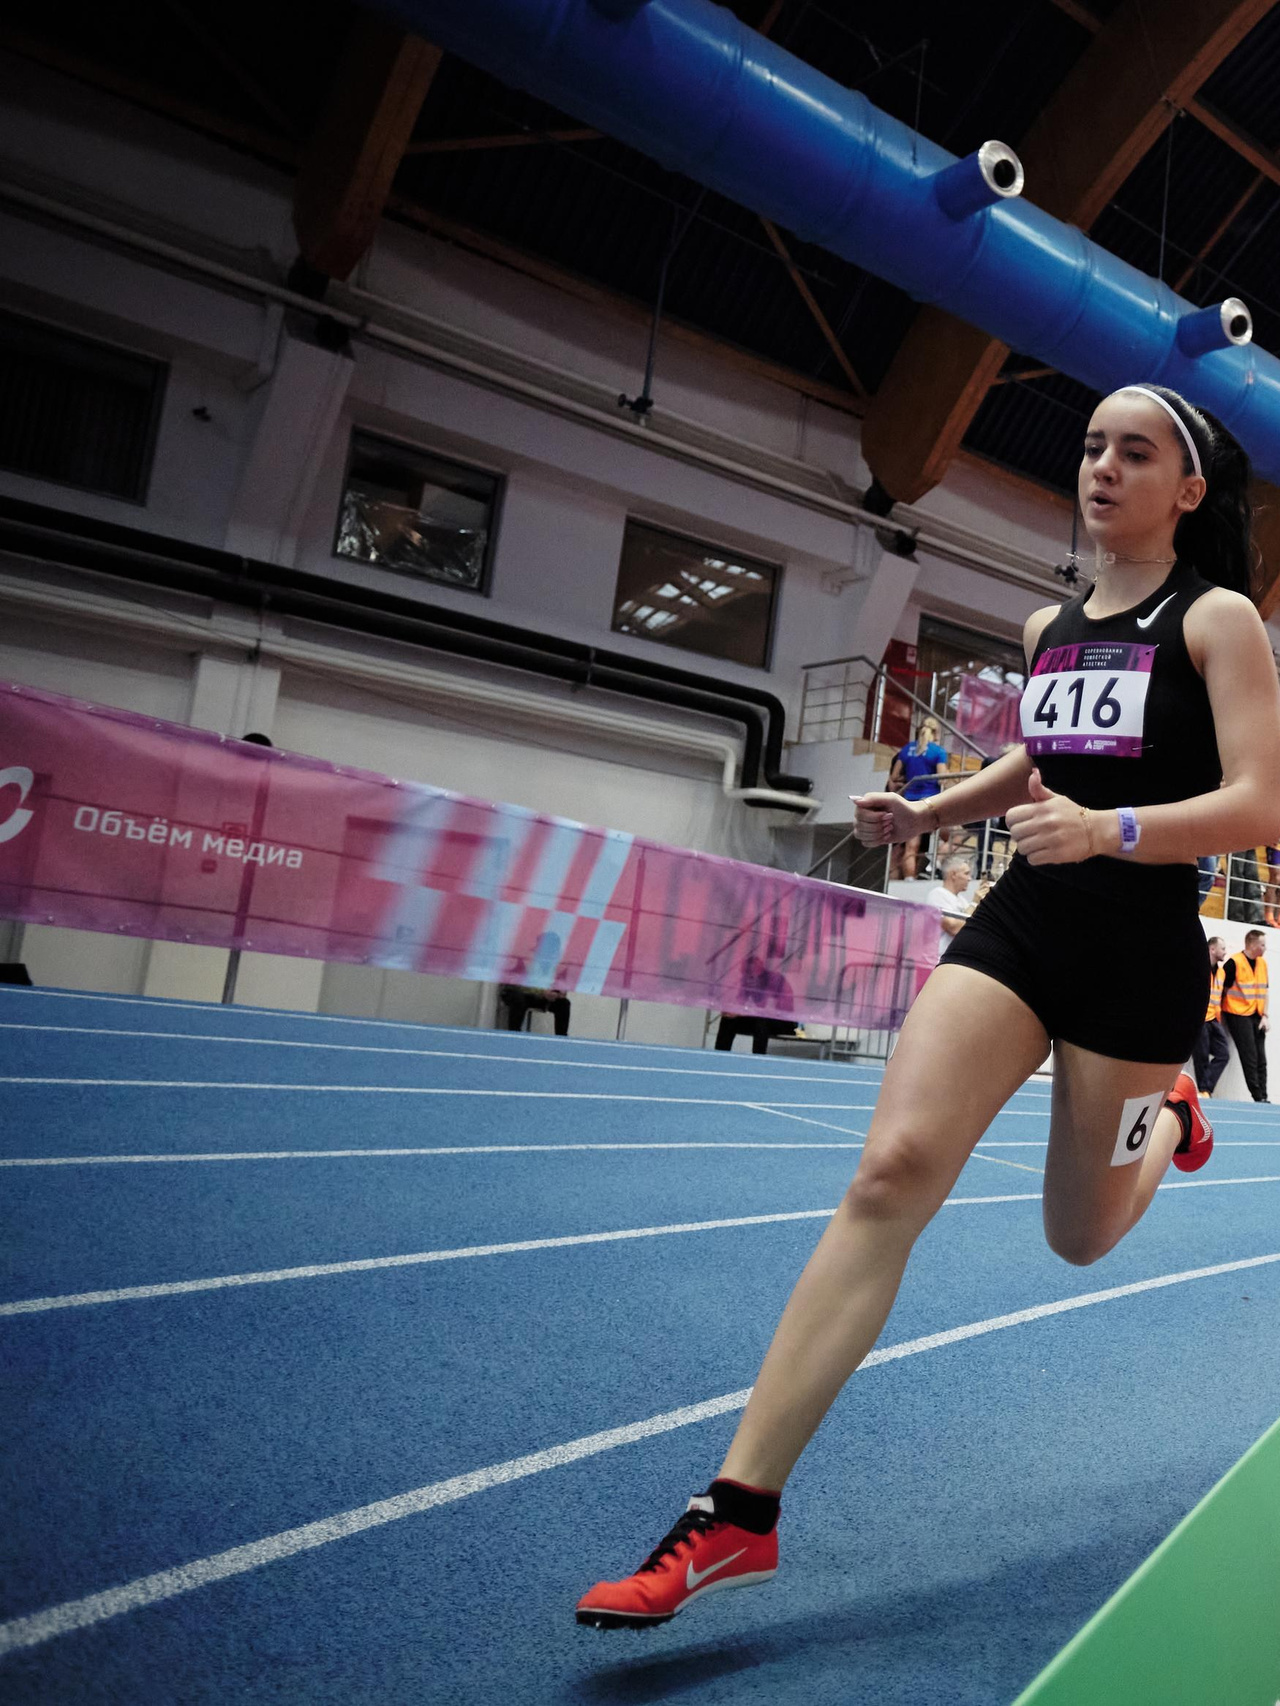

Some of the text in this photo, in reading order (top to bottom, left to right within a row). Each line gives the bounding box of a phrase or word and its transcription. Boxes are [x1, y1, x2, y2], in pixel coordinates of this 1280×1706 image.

[1033, 677, 1122, 729] 416
[73, 806, 304, 869] Объём медиа
[1125, 1105, 1150, 1152] 6
